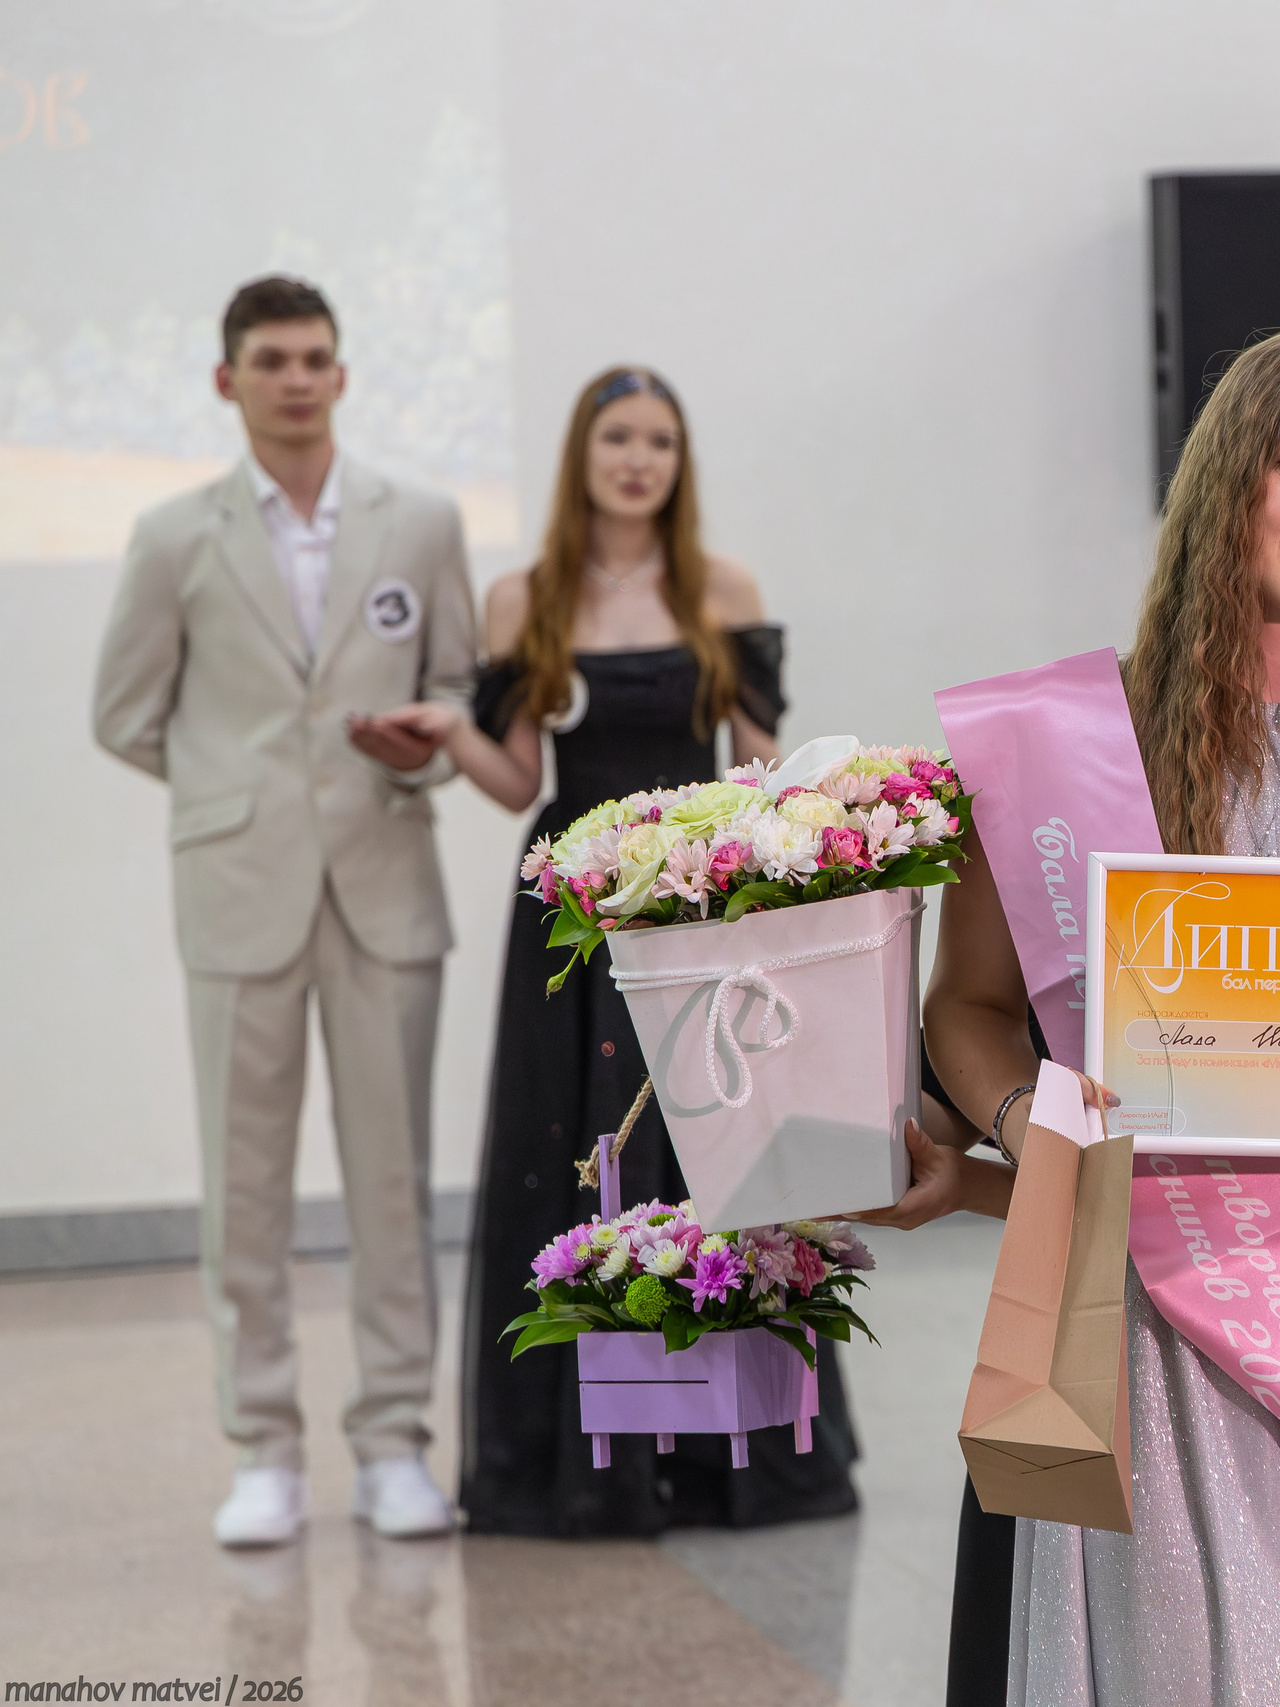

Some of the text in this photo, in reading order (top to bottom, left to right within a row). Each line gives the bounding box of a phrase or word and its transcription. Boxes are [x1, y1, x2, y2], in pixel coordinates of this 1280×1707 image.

[373, 588, 410, 628] 3
[1032, 816, 1081, 943] Бала
[1221, 973, 1252, 990] бал
[1137, 1010, 1209, 1020] награждается
[1159, 1022, 1216, 1047] Лада
[1136, 1053, 1151, 1066] За
[1200, 1057, 1260, 1069] номинации
